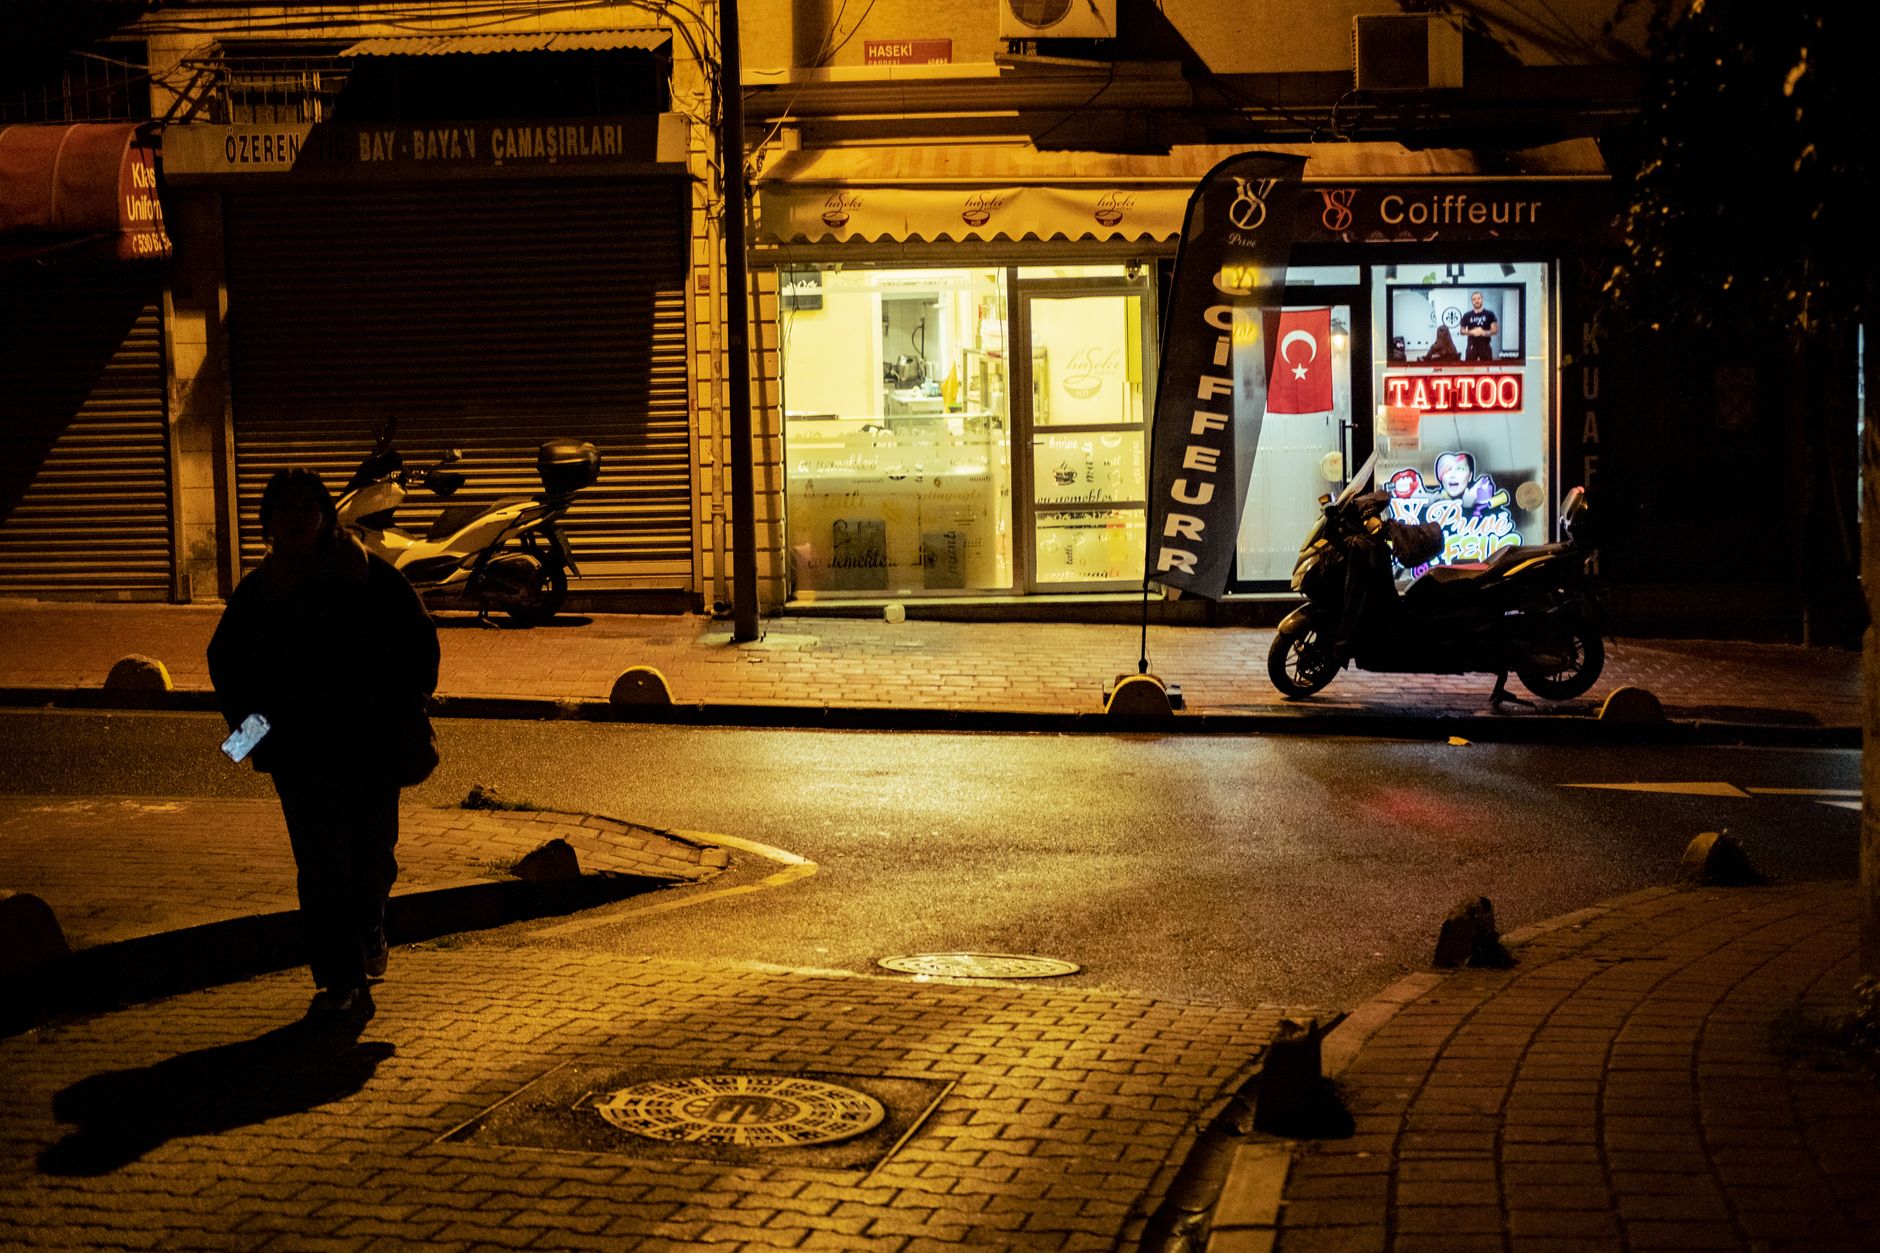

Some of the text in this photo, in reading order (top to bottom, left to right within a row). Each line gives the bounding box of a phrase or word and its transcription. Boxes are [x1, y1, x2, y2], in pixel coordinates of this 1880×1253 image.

[225, 127, 300, 164] ÖZEREN
[359, 130, 395, 162] BAY
[413, 128, 477, 160] BAYAN
[491, 125, 624, 166] ÇAMAŞIRLARI
[1379, 194, 1543, 225] Coiffeurr
[1388, 375, 1519, 410] TATTOO
